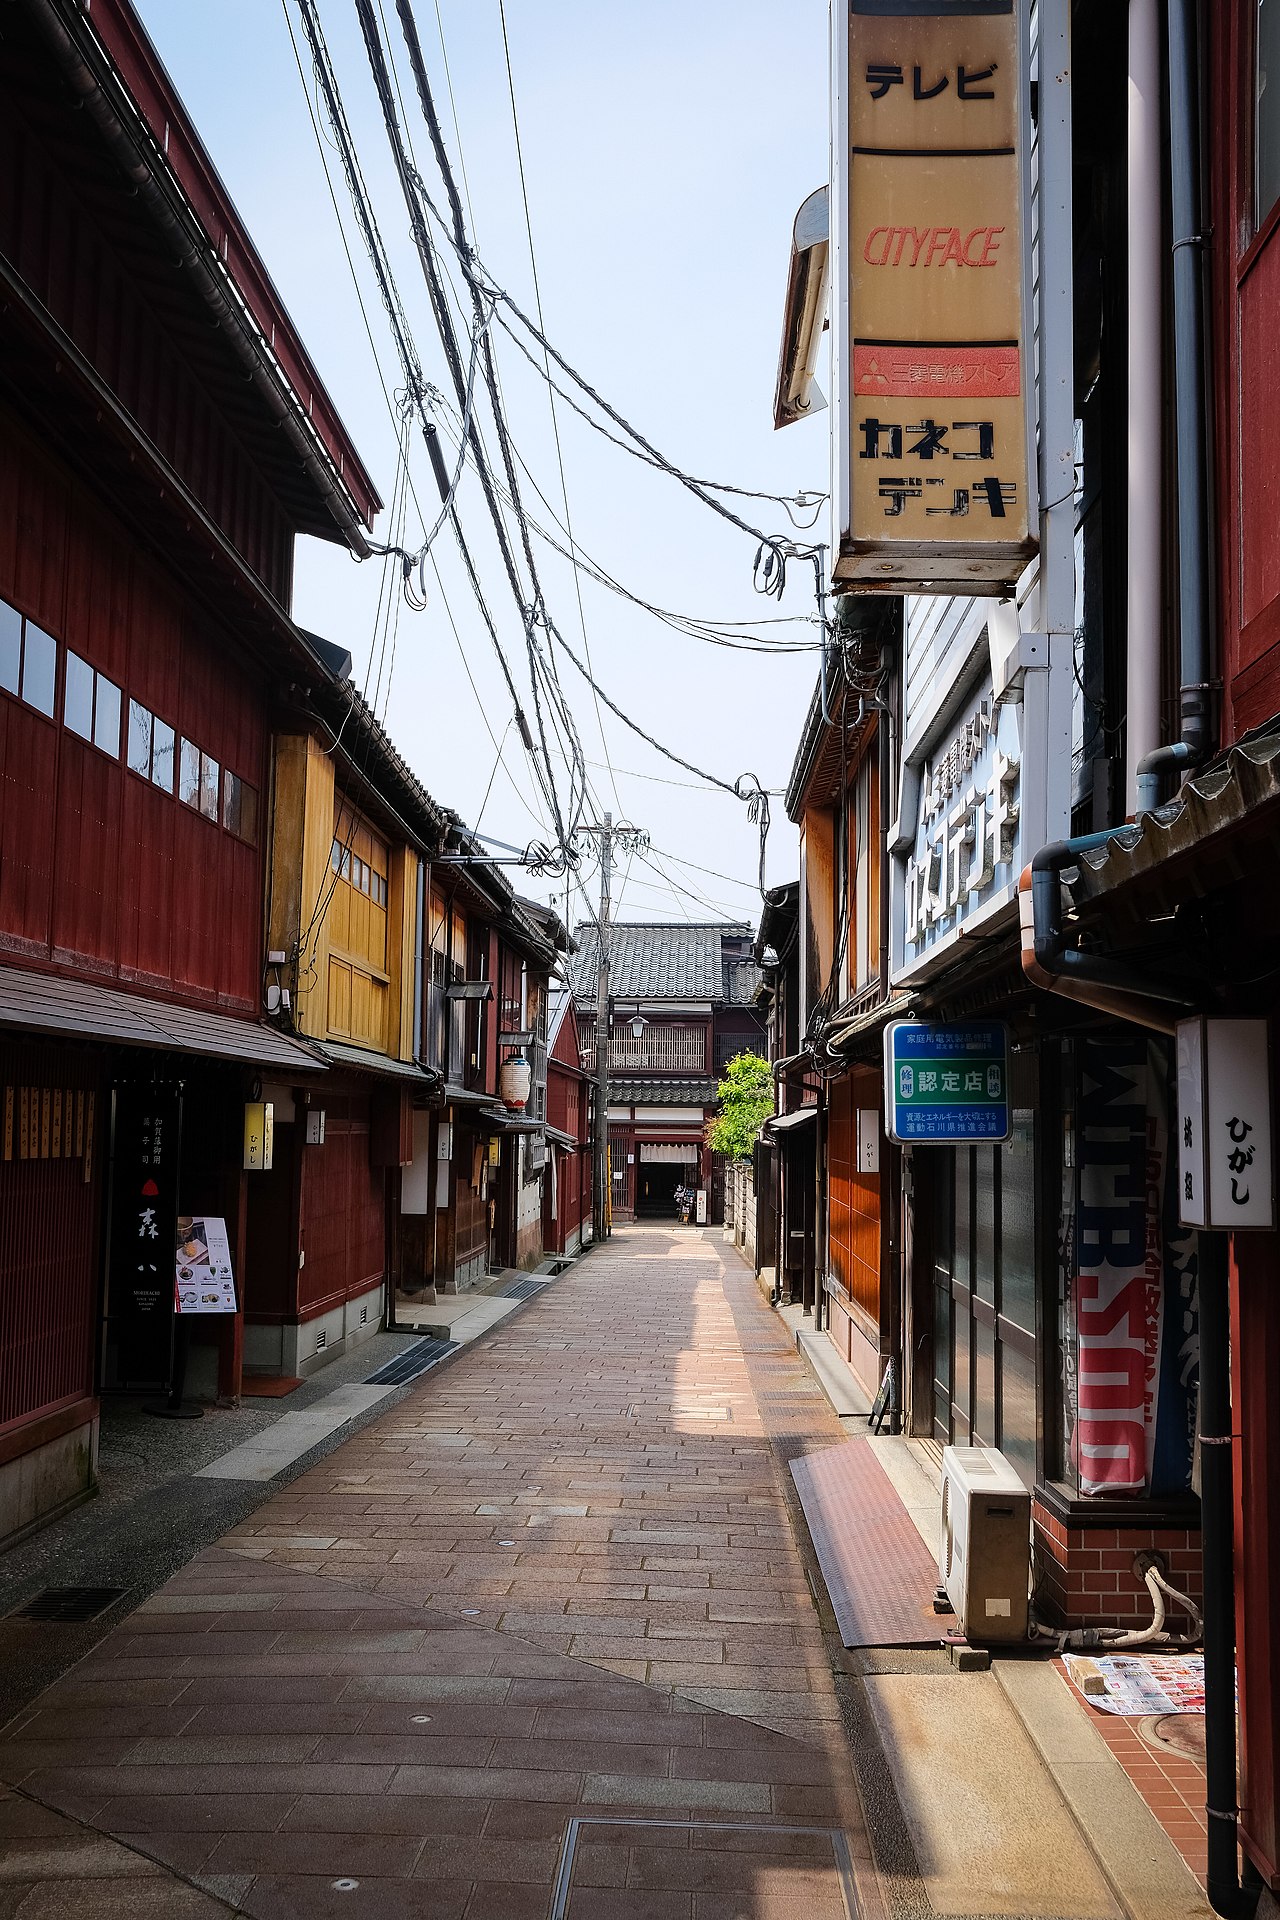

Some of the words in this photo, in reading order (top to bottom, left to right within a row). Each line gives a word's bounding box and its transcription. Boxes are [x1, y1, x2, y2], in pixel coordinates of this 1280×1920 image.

[865, 63, 999, 100] テレビ
[863, 226, 1006, 267] CITYFACE
[891, 361, 1017, 384] 三菱電機ストア
[859, 418, 994, 460] カネコ
[878, 477, 1017, 518] デンキ
[900, 1069, 912, 1094] 修理
[918, 1071, 983, 1092] 認定店
[988, 1068, 1000, 1094] 相談
[906, 1112, 997, 1122] 資源とエネルギーを大切にする
[906, 1122, 997, 1133] 運動石川県推進会議
[250, 1135, 258, 1163] ひがし
[866, 1143, 874, 1168] ひがし
[1225, 1117, 1256, 1205] ひがし
